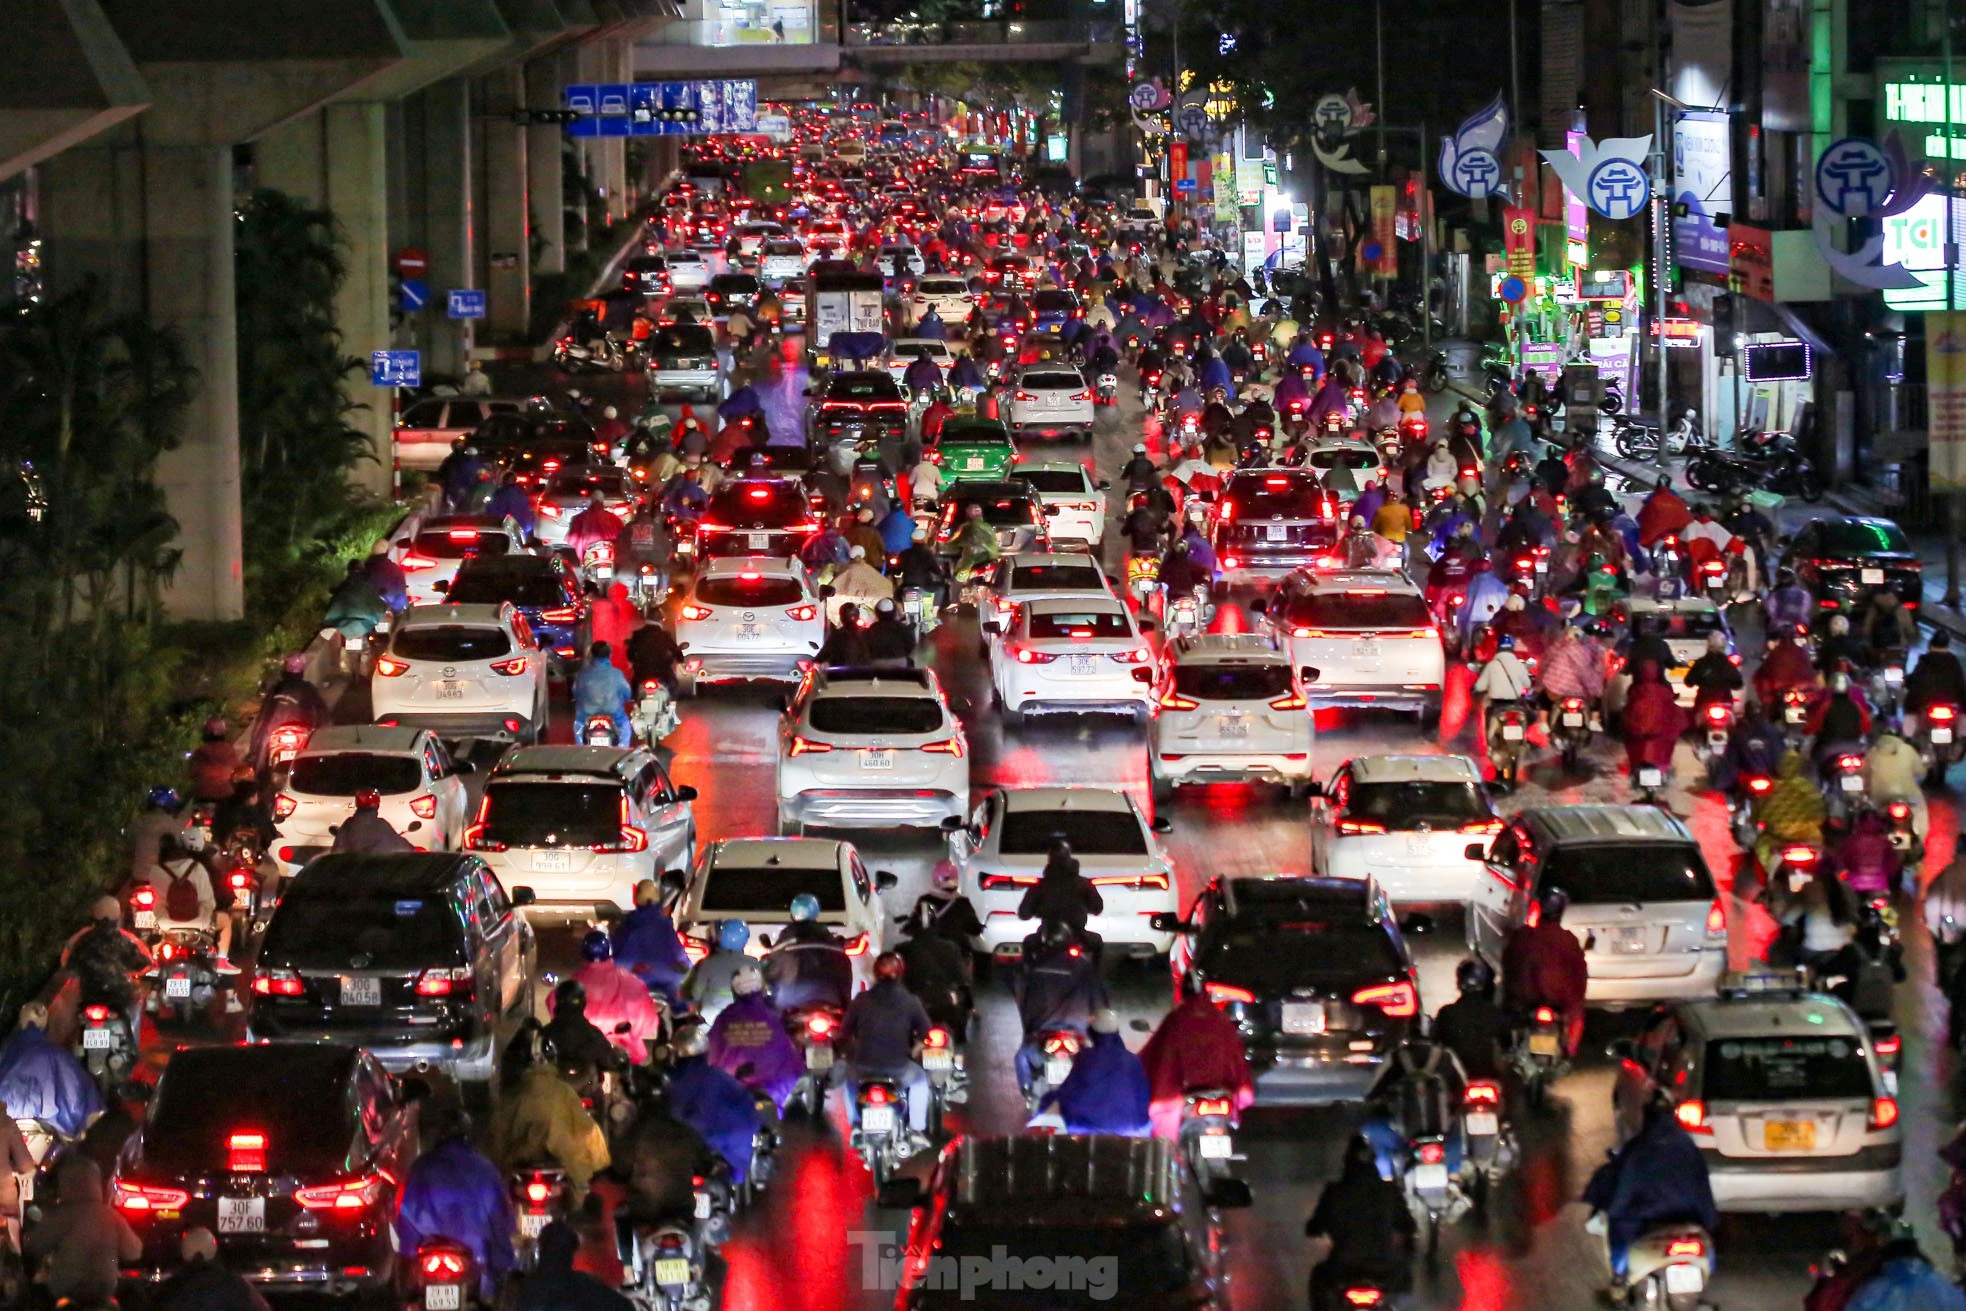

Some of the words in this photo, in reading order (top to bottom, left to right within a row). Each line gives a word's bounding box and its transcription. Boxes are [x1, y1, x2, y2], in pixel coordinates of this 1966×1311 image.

[1891, 218, 1938, 249] TCI
[352, 978, 371, 991] 30G
[231, 1200, 252, 1215] 30F
